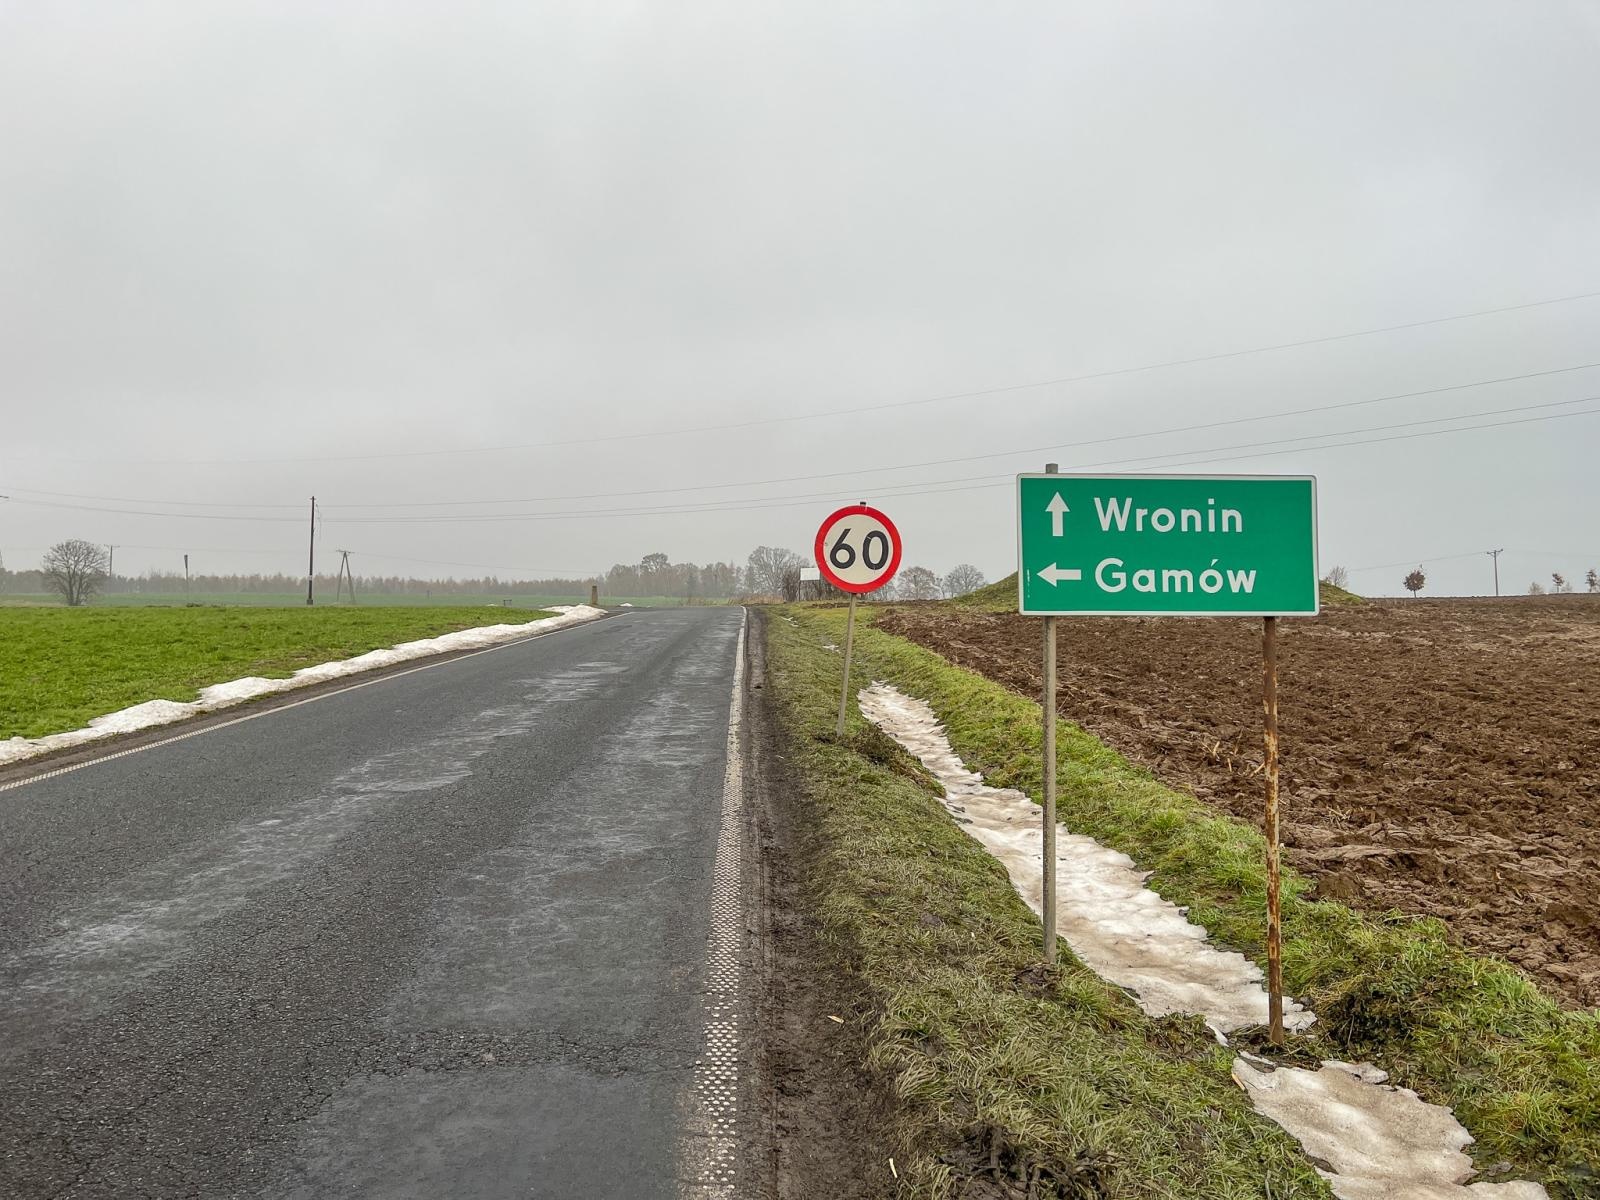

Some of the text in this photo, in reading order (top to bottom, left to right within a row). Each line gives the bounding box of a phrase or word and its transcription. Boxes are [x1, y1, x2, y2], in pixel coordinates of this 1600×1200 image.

[1094, 497, 1243, 533] Wronin
[829, 528, 889, 571] 60
[1094, 557, 1257, 593] Gamów
